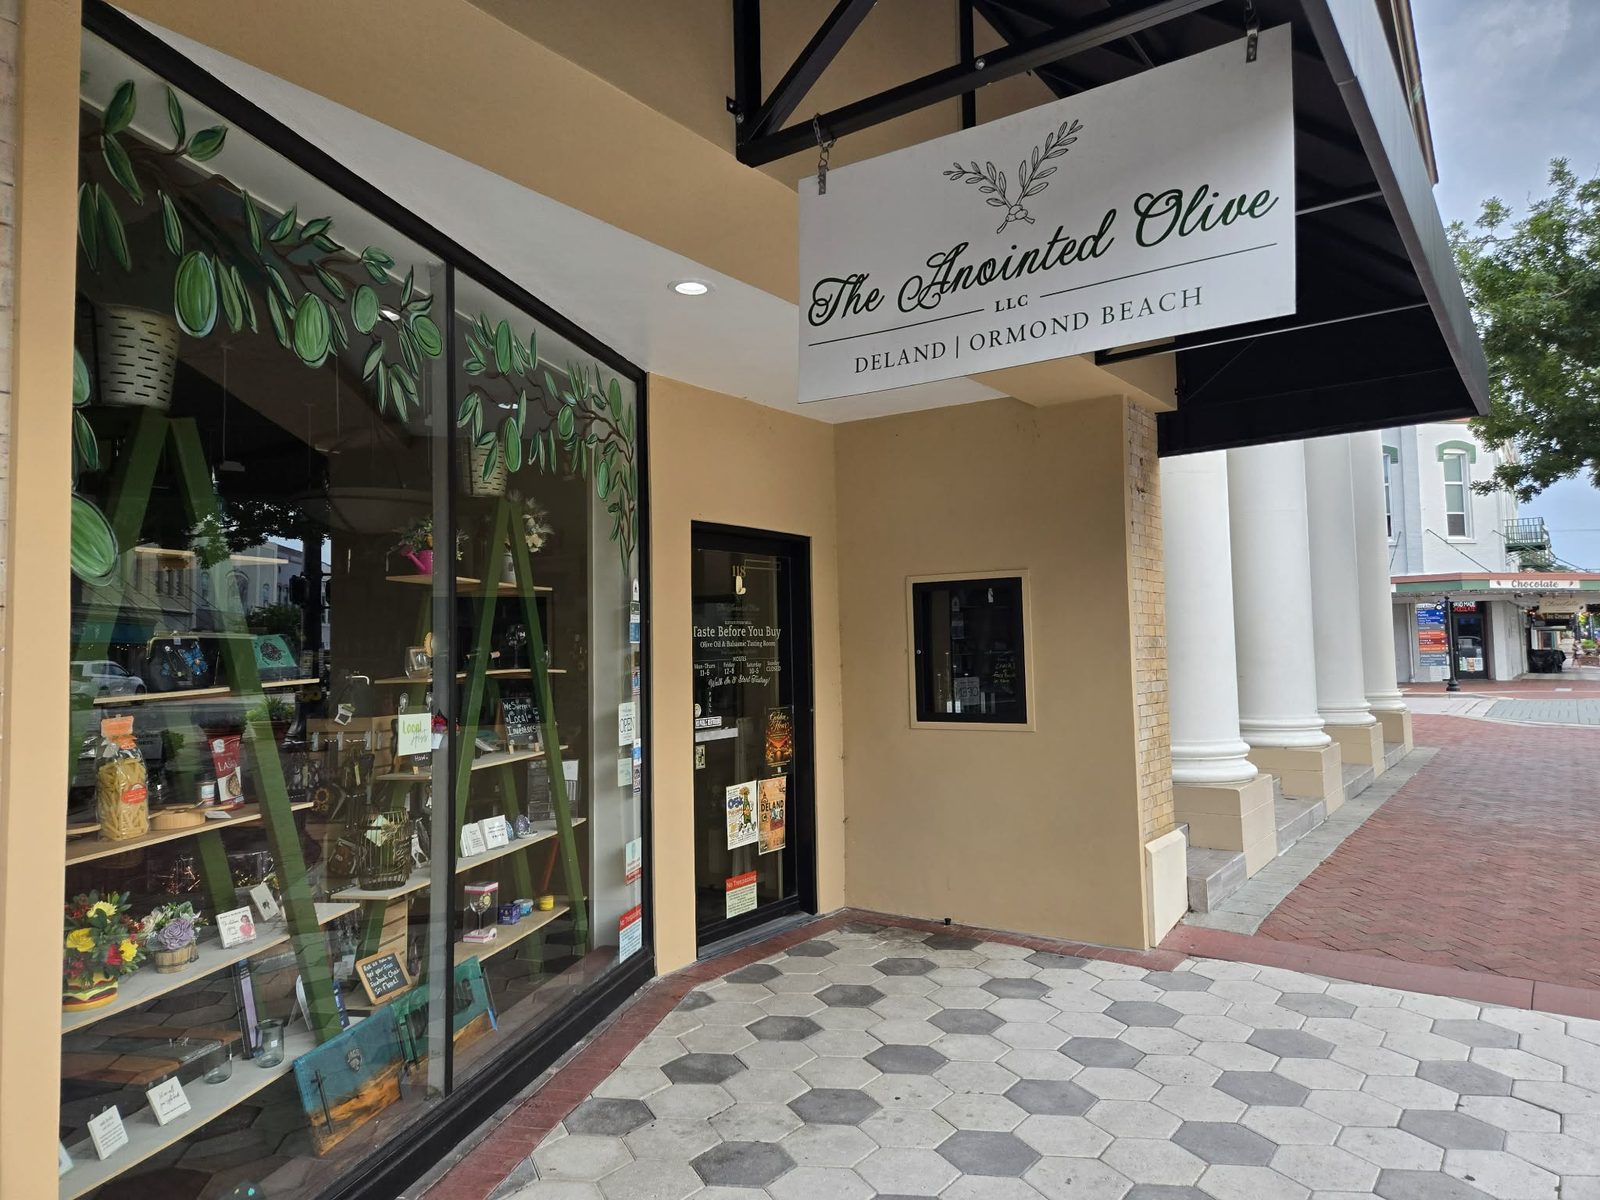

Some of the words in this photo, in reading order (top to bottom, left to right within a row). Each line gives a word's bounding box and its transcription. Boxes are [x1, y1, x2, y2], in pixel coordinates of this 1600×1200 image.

[808, 274, 885, 327] The
[897, 209, 1117, 313] Anointed
[1134, 184, 1278, 247] Olive
[994, 294, 1029, 313] LLC
[855, 341, 946, 374] DELAND
[969, 311, 1090, 351] ORMOND
[1100, 286, 1203, 326] BEACH
[1511, 579, 1560, 589] Chocolate
[693, 626, 716, 638] Taste
[718, 625, 746, 637] Before
[748, 625, 764, 637] You
[765, 626, 781, 640] Buy
[700, 640, 713, 648] Olive
[713, 640, 721, 648] Oil
[747, 640, 762, 648] Tasting
[508, 713, 528, 724] Local
[402, 720, 422, 734] Local
[761, 799, 784, 812] DELAND
